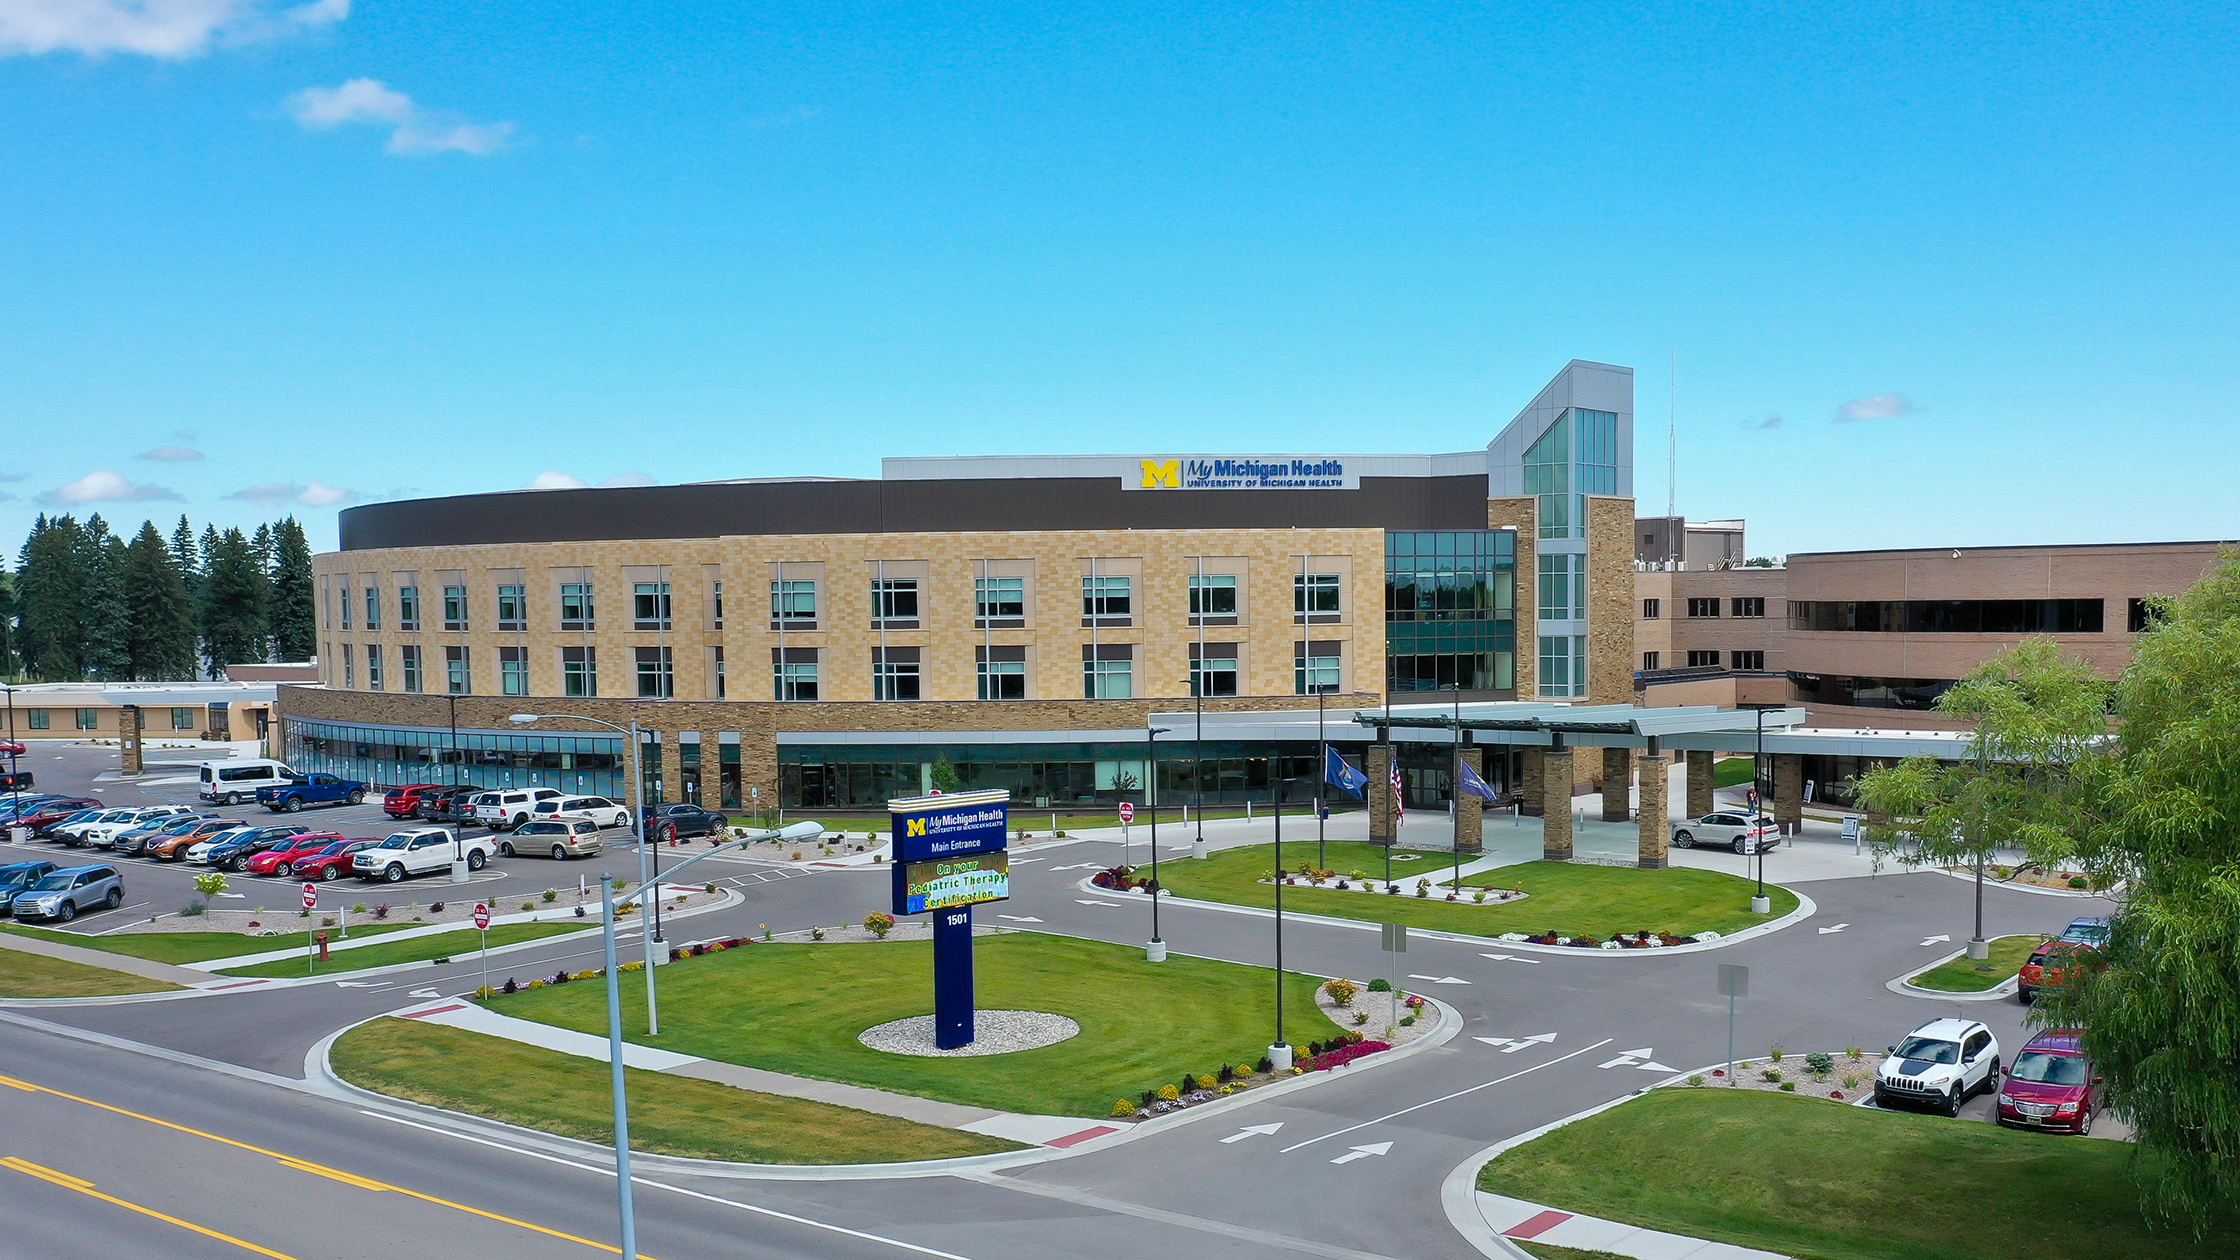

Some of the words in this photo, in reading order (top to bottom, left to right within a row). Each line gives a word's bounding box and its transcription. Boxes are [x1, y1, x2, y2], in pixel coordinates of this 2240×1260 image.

[1141, 460, 1180, 488] M
[1292, 459, 1343, 477] Health
[1187, 480, 1243, 488] UNIVERSITY
[979, 809, 1003, 821] Health
[907, 818, 926, 837] M
[932, 843, 949, 852] Main
[951, 840, 980, 850] Entrance
[937, 864, 950, 875] On
[954, 861, 978, 874] your
[908, 880, 959, 895] Pediatric
[964, 873, 1006, 886] Therapy
[924, 890, 994, 908] Certification
[947, 913, 967, 925] 1501
